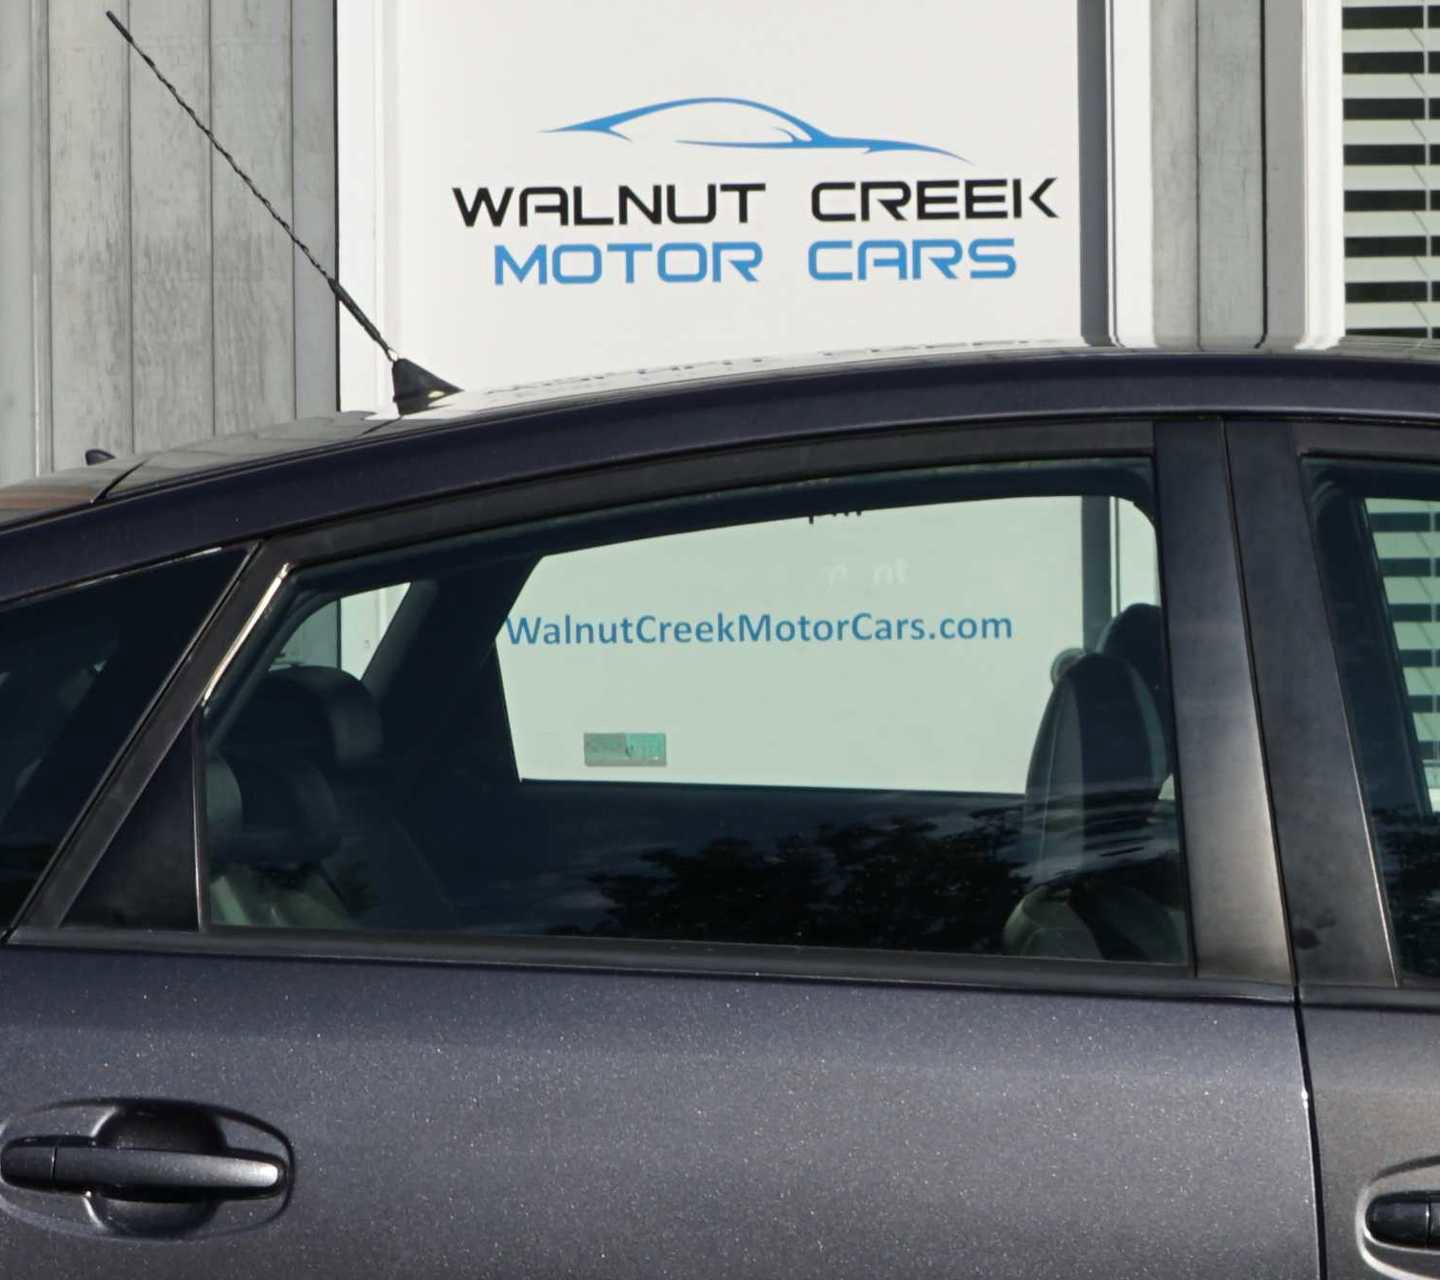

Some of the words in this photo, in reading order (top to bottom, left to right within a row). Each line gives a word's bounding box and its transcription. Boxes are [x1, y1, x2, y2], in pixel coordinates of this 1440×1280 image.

[452, 183, 766, 227] WALNUT
[811, 177, 1059, 222] CREEK
[494, 240, 764, 286] MOTOR
[807, 237, 1017, 281] CARS
[507, 612, 1014, 646] WalnutCreekMotorCars.com
